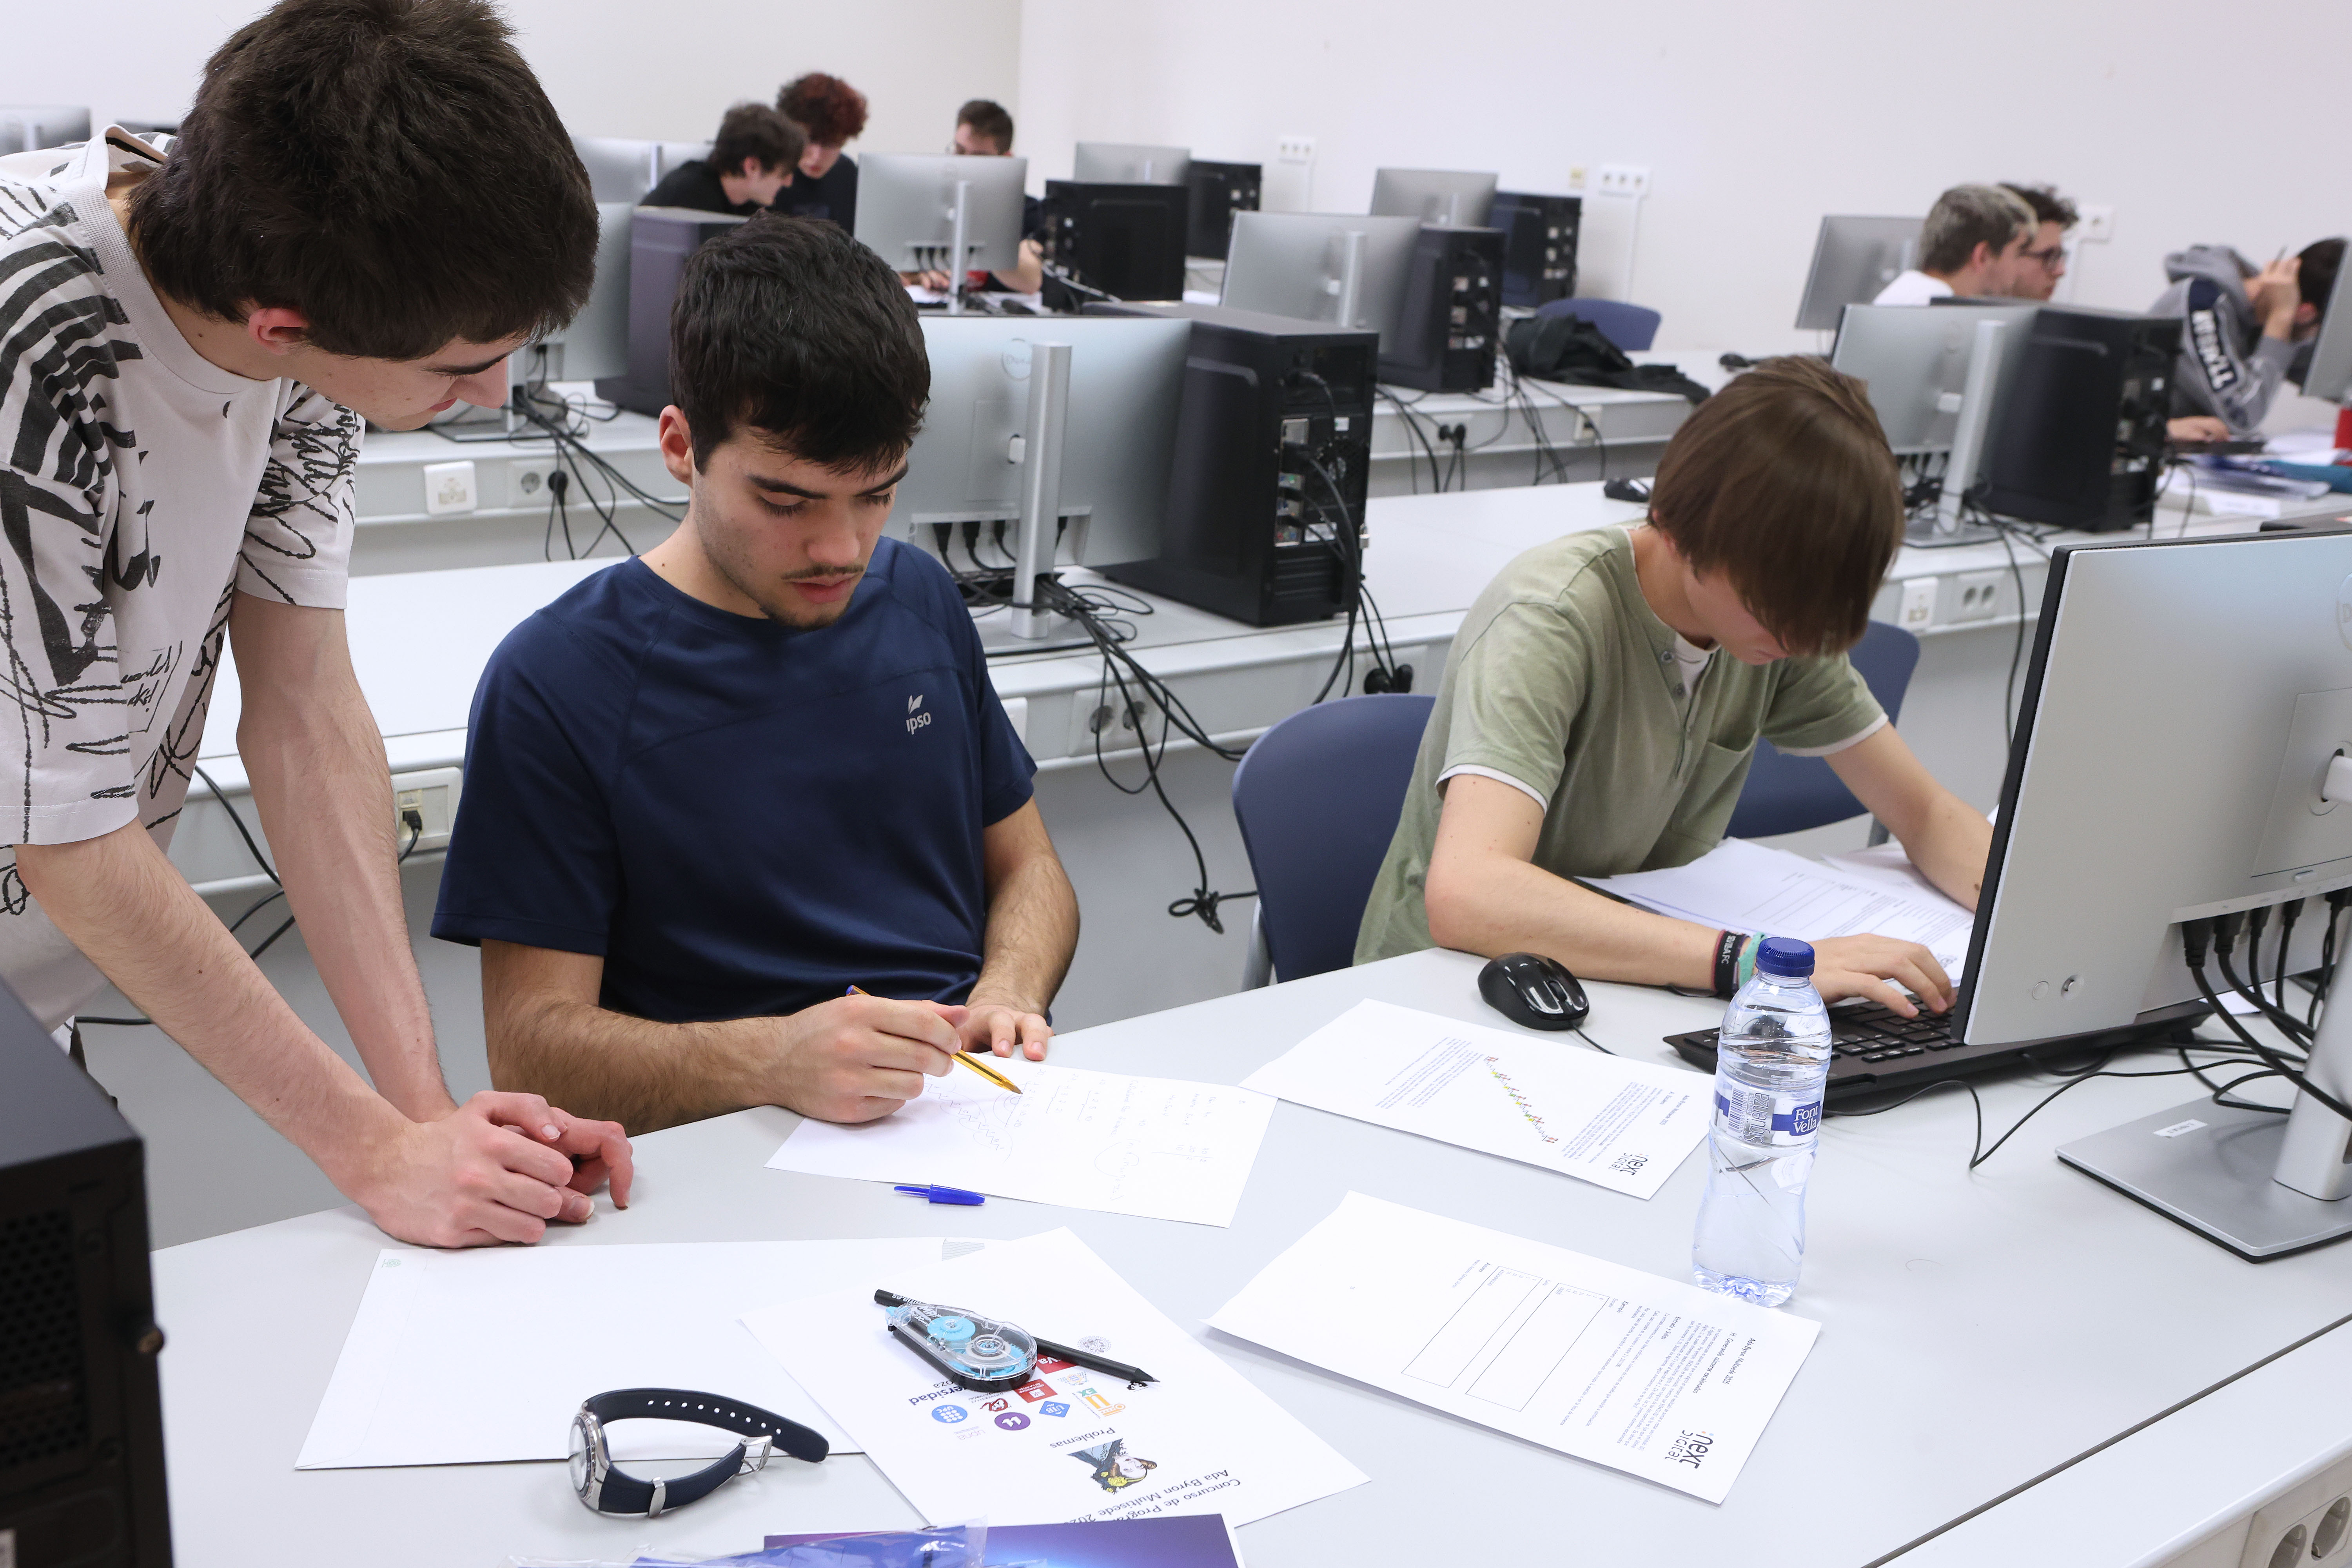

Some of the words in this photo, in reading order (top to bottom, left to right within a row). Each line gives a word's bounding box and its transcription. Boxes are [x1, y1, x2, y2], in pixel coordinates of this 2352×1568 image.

[1743, 1093, 1770, 1143] Sigüenza
[1794, 1106, 1819, 1122] Font
[1793, 1118, 1817, 1134] Vella
[1619, 1155, 1648, 1175] next
[1035, 1354, 1060, 1366] Va
[936, 1404, 954, 1414] UPC
[1045, 1405, 1065, 1413] UIB
[1050, 1427, 1116, 1448] Problemas
[1679, 1434, 1713, 1469] next
[1204, 1470, 1229, 1480] Ada
[1163, 1479, 1202, 1493] Byron
[1183, 1479, 1241, 1499] Concurso
[1098, 1492, 1161, 1515] Multisede
[1061, 1514, 1096, 1530] 202
